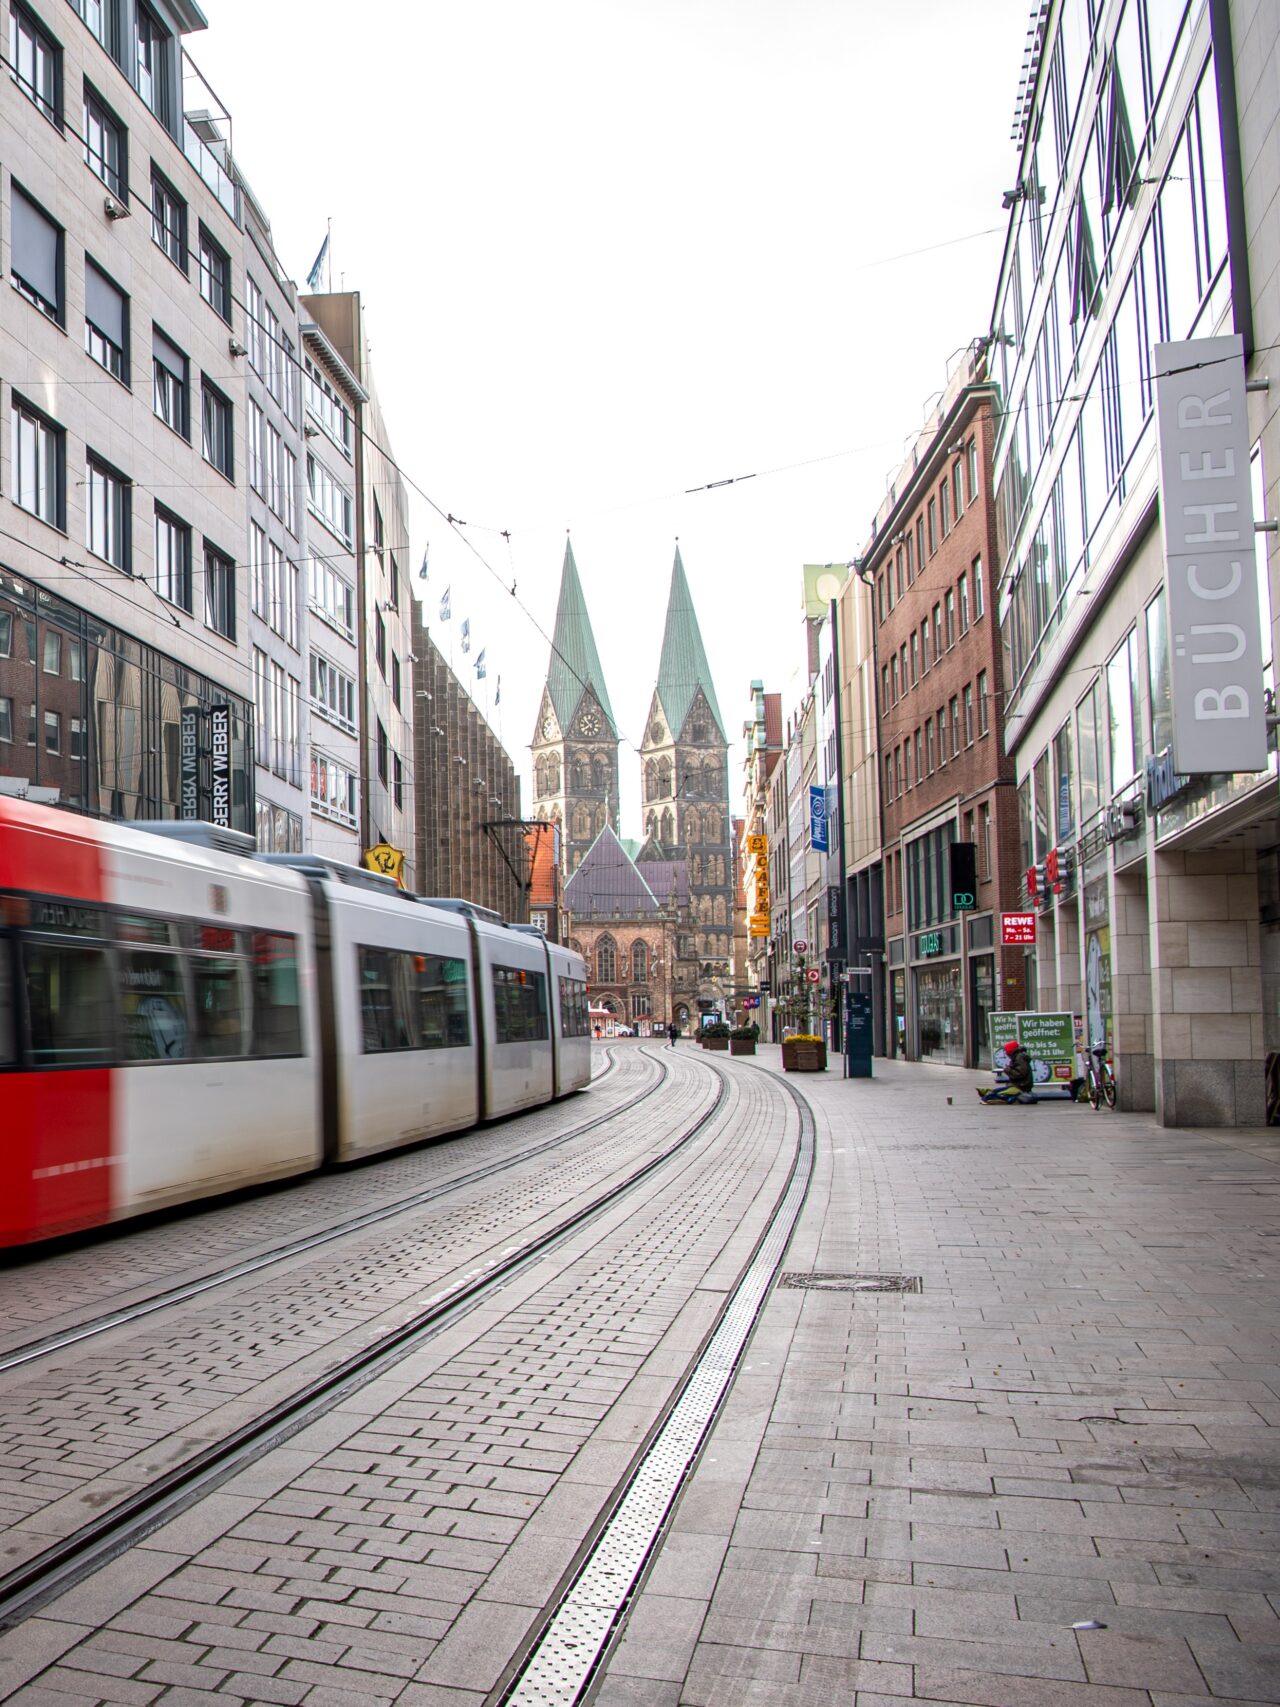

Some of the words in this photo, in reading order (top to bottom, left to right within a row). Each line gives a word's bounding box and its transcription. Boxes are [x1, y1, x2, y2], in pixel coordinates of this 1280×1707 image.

[1175, 389, 1251, 721] BÜCHER
[212, 710, 228, 771] WEBER
[213, 774, 229, 828] GERRY
[1004, 917, 1034, 926] REWE
